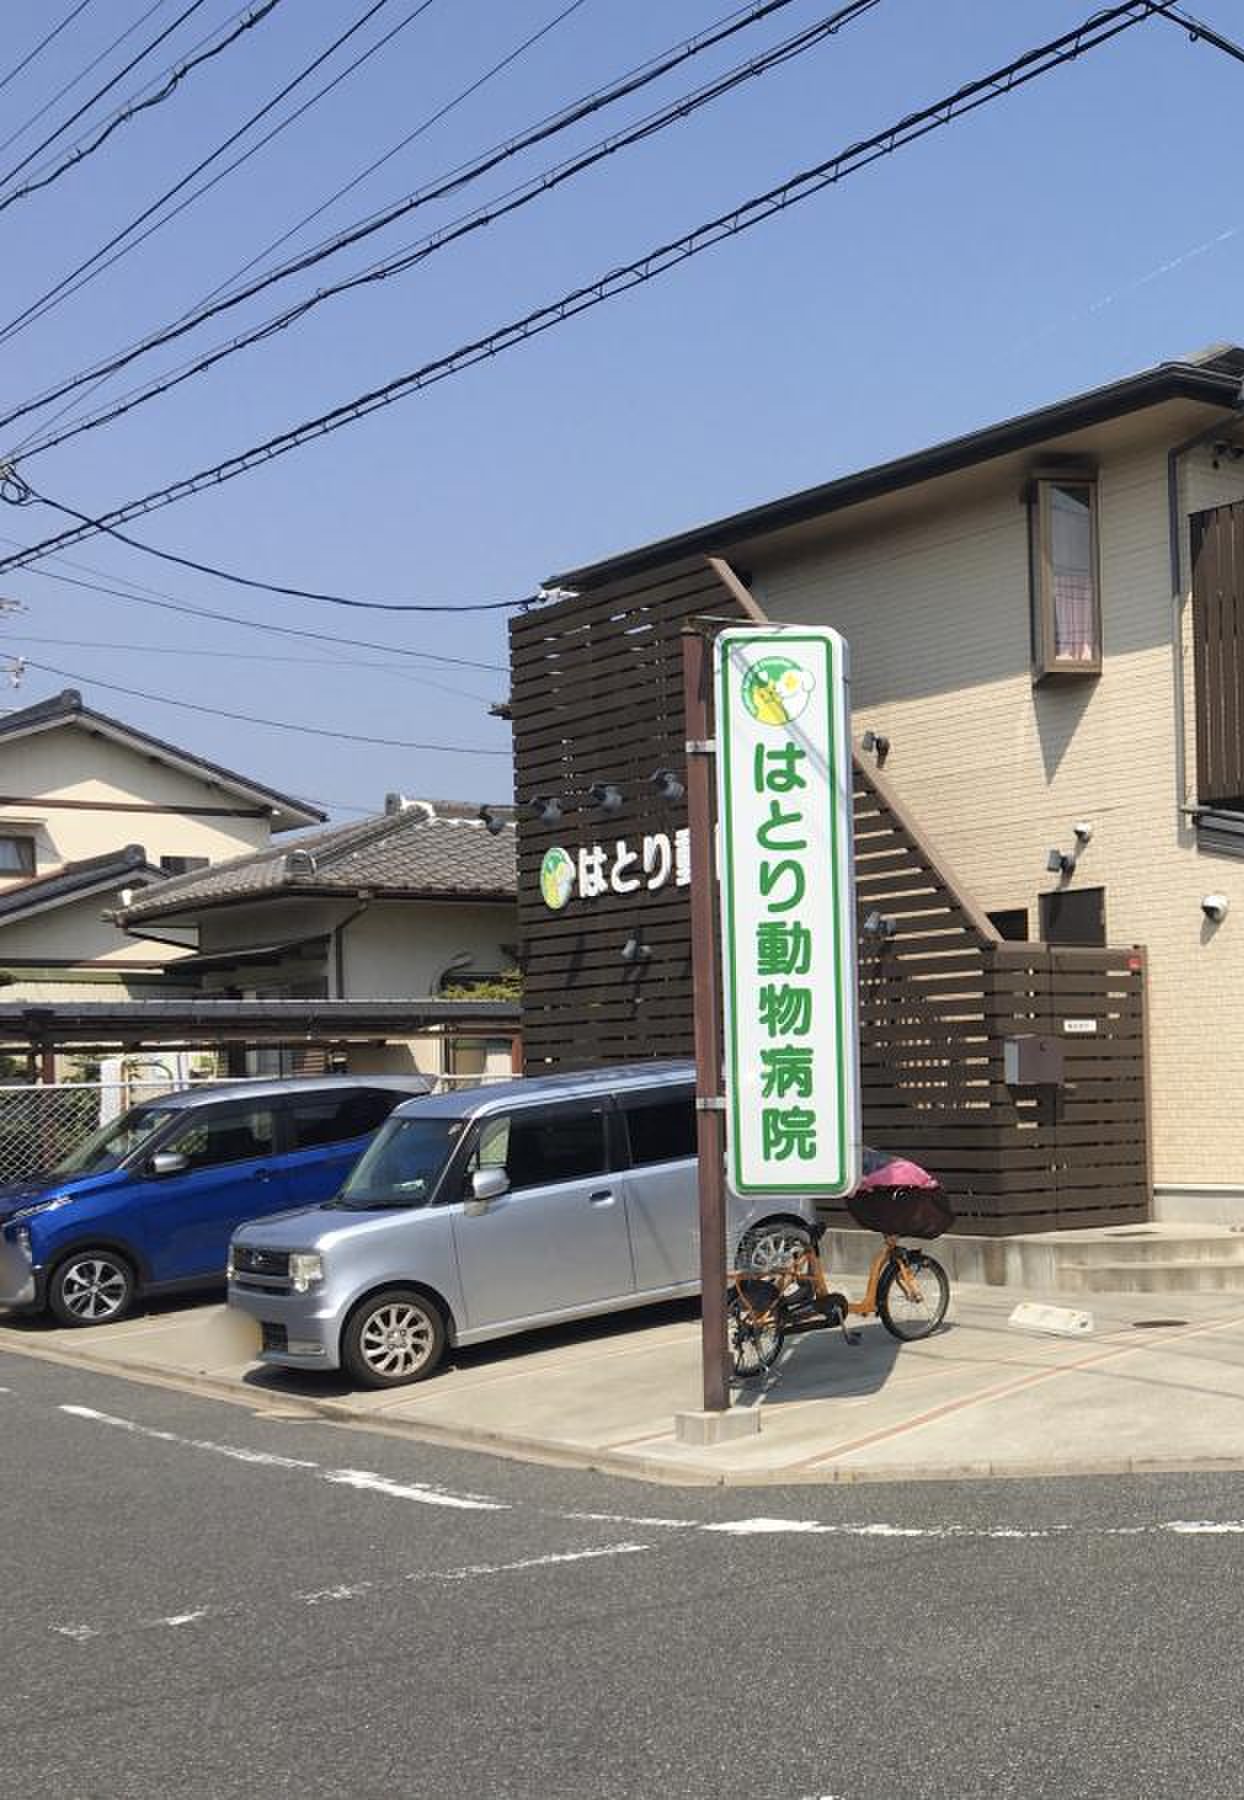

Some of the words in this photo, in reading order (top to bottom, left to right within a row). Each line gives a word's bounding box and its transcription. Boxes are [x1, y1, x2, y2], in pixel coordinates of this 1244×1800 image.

[754, 742, 817, 1161] はとり動物病院
